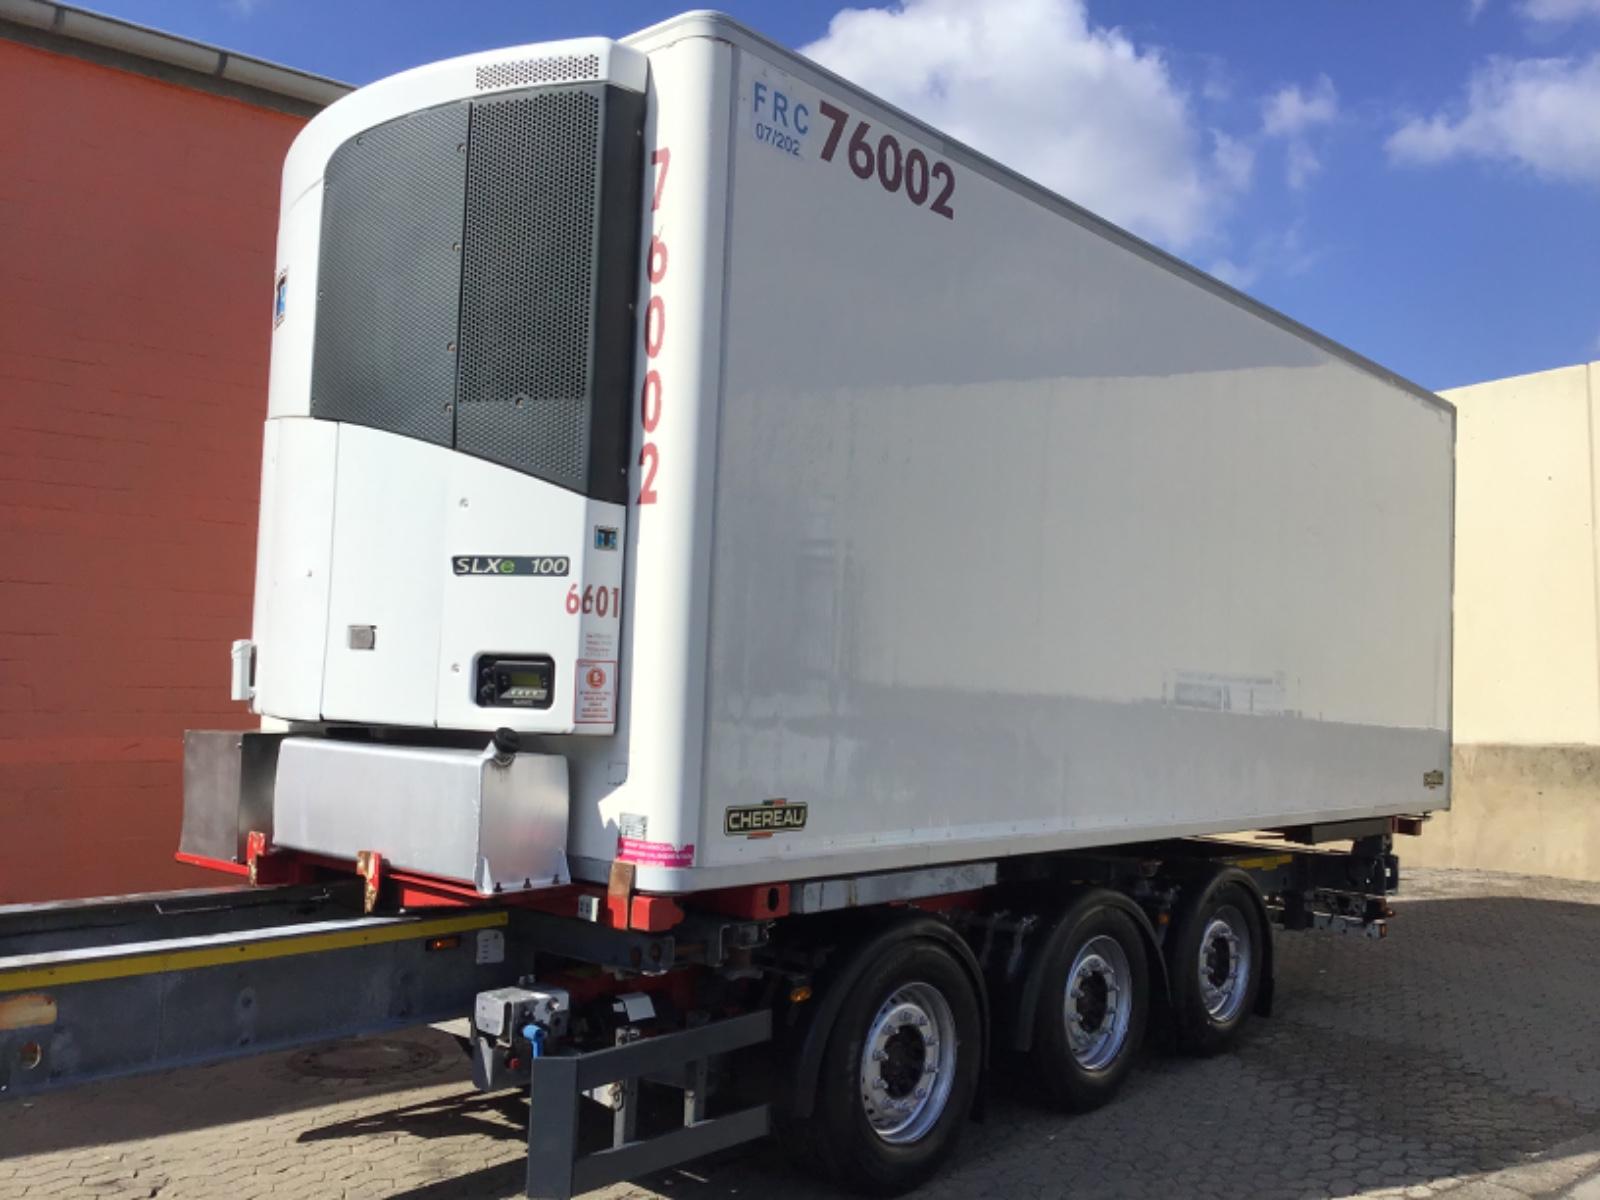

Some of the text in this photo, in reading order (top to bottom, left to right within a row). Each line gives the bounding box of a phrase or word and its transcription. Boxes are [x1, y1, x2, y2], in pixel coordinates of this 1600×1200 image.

[754, 81, 809, 135] FRC
[819, 99, 956, 221] 76002
[637, 147, 671, 505] 76002
[531, 558, 568, 573] 100
[565, 583, 620, 619] 6601
[729, 808, 805, 828] CHEREAU
